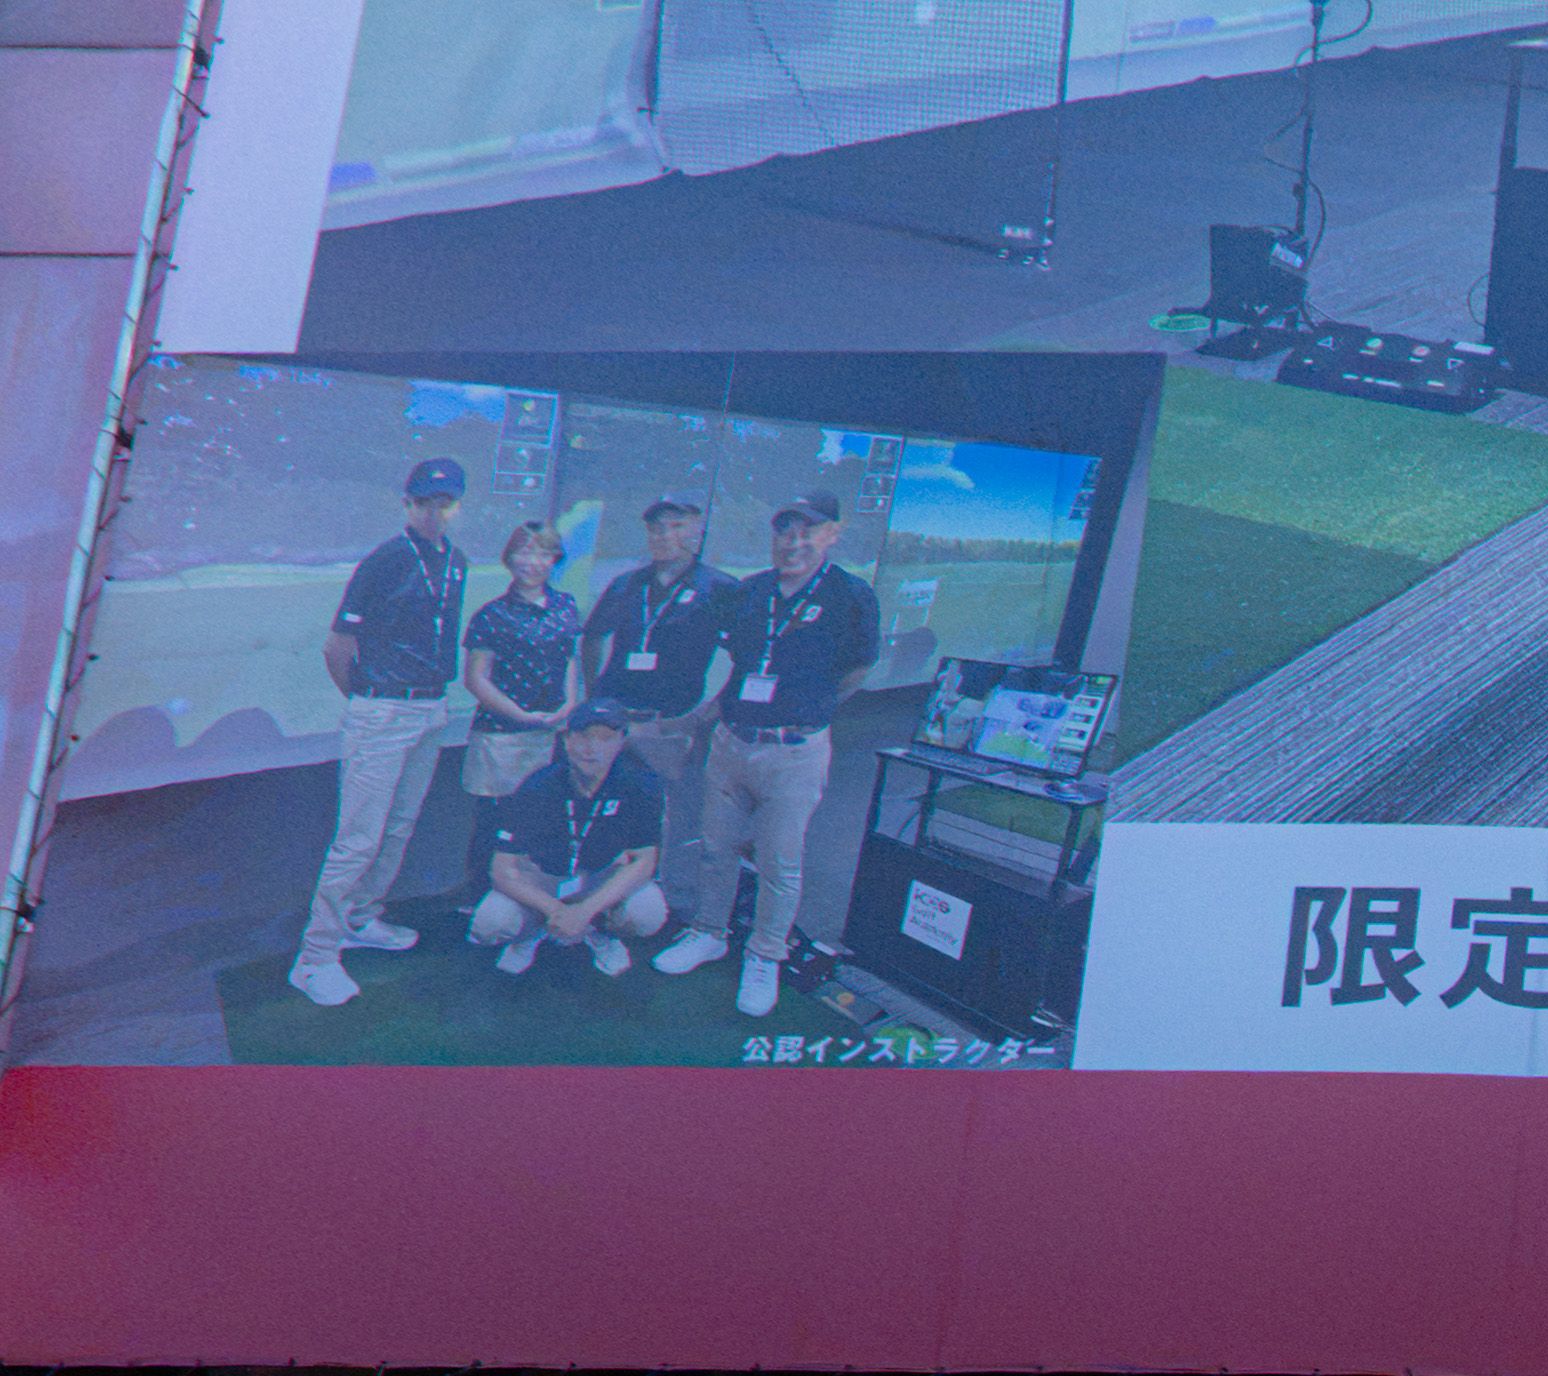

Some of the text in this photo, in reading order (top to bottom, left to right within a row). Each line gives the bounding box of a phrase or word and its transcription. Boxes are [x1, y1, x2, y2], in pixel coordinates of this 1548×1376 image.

[741, 1033, 1057, 1066] 公認インストラクター
